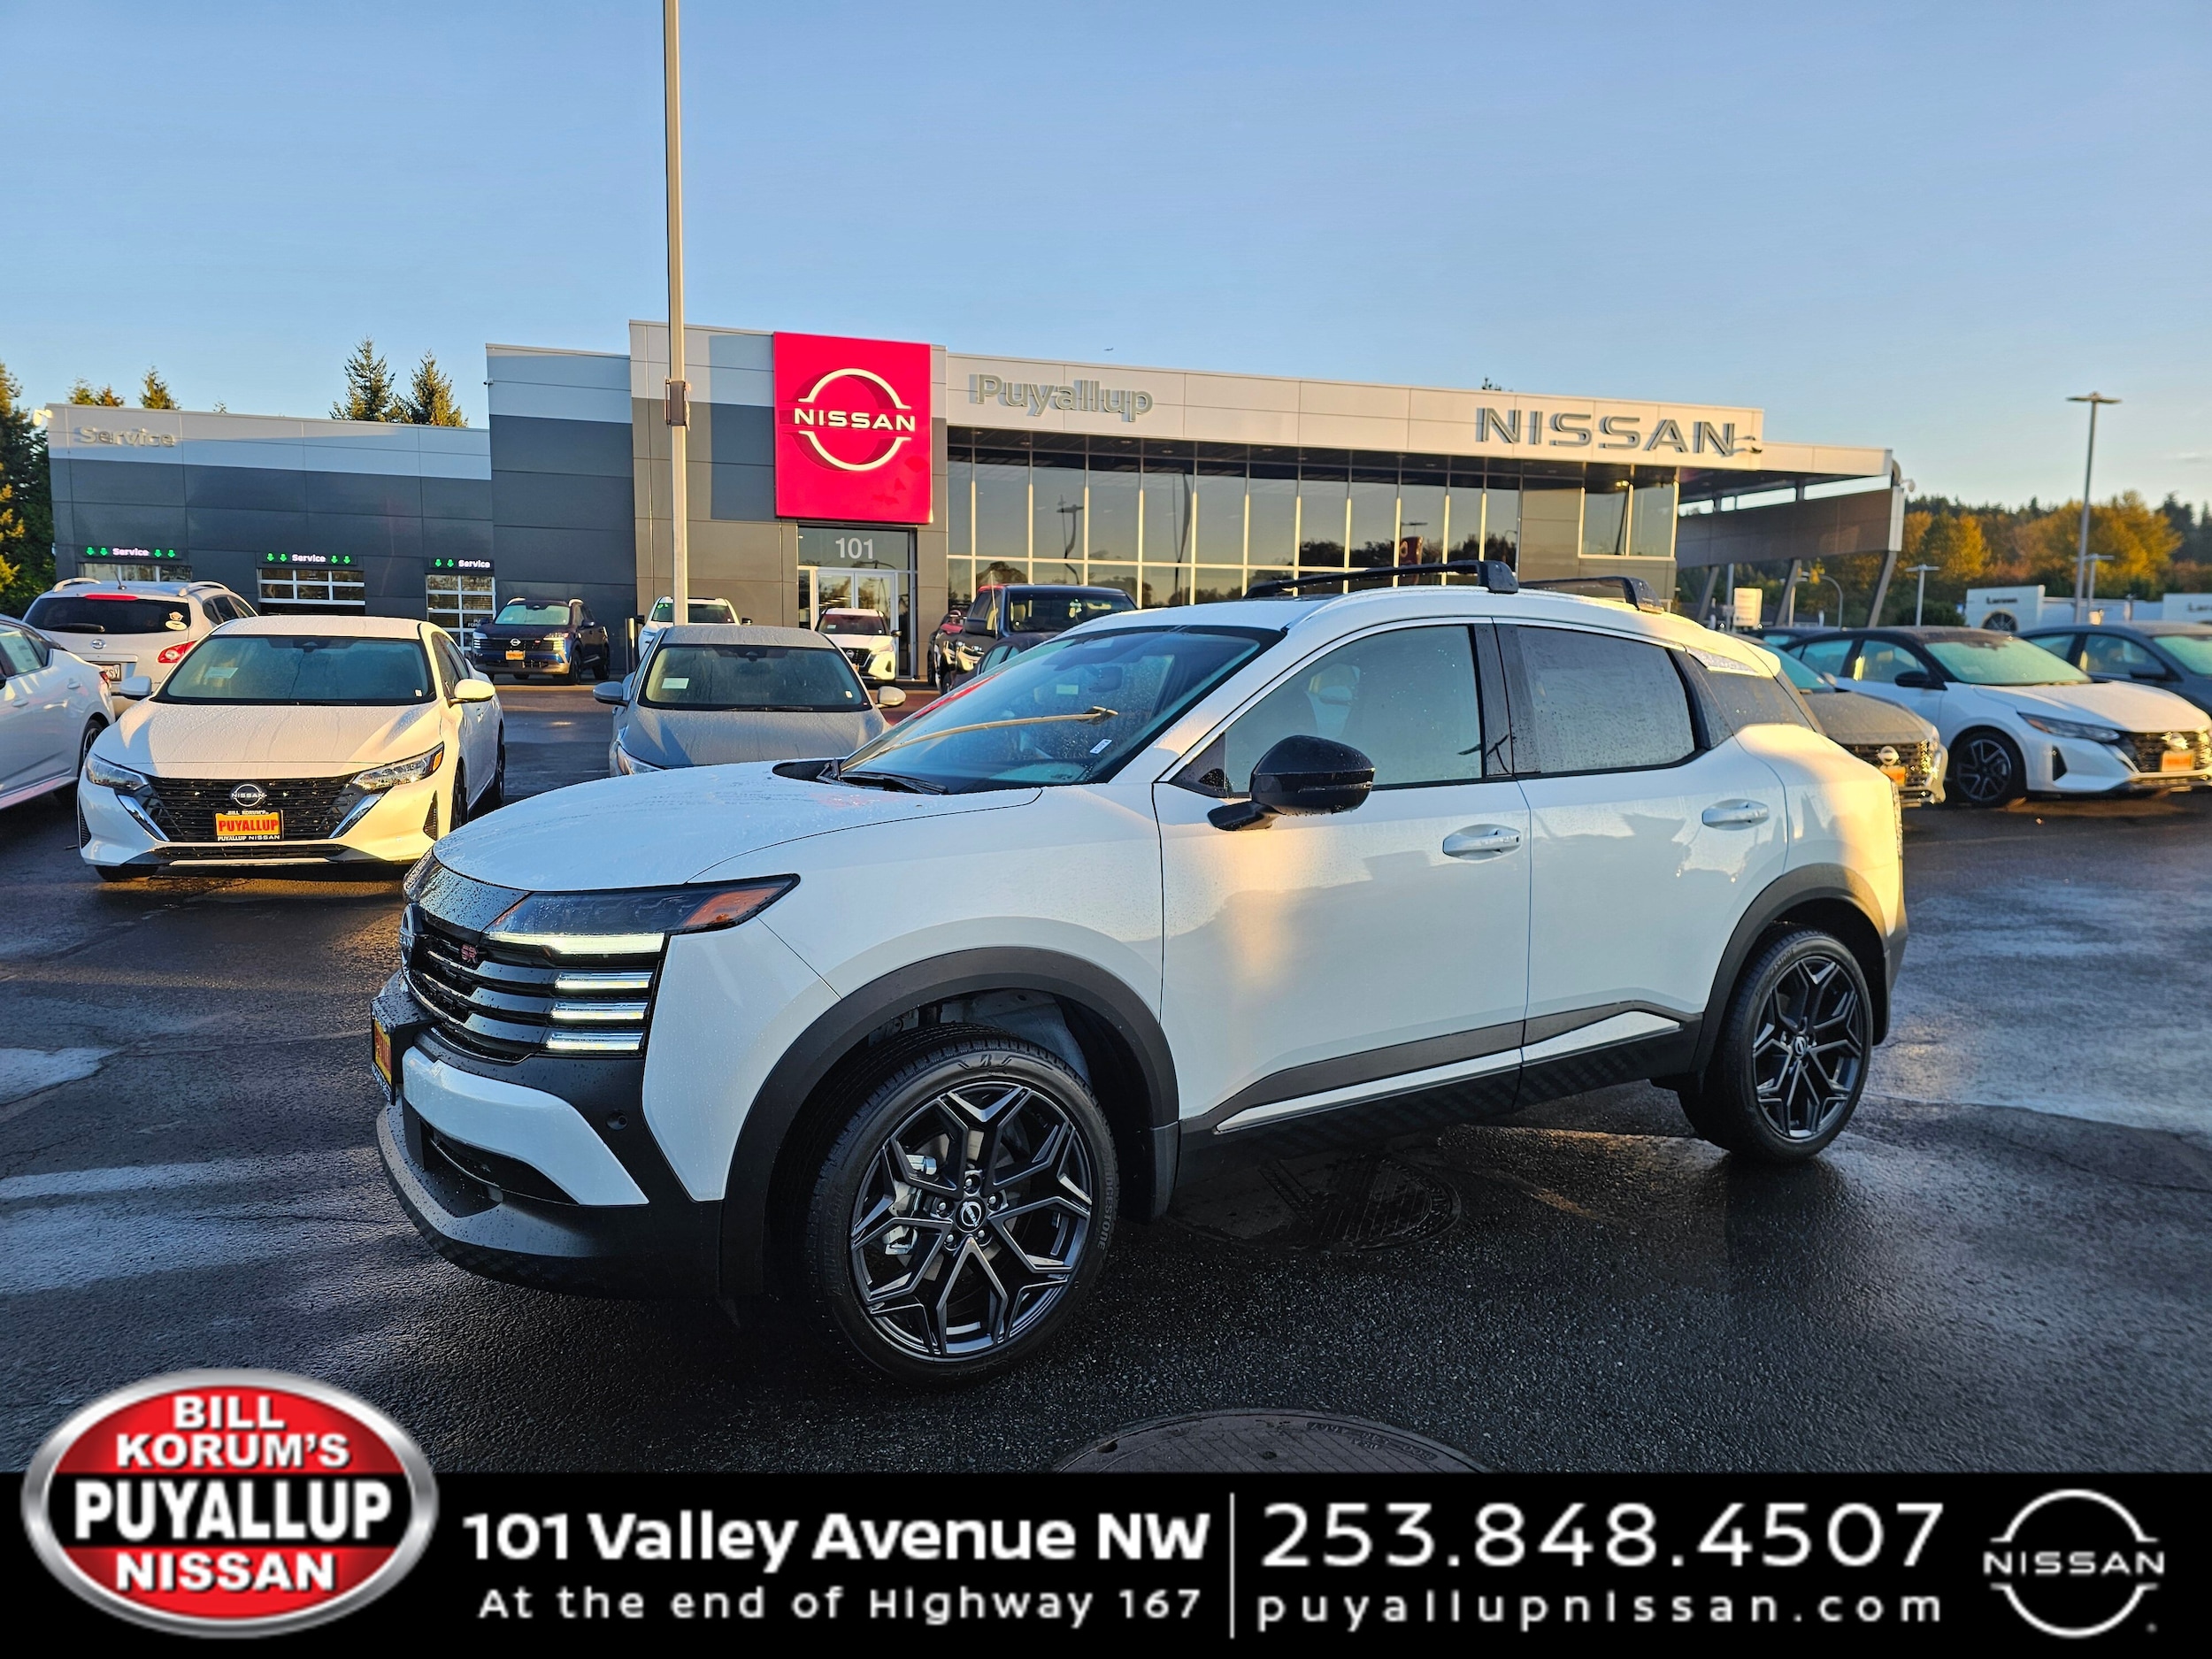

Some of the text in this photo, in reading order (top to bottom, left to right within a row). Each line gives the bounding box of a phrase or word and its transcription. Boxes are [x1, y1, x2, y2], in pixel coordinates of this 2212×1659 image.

[977, 374, 1153, 422] Puyallup
[794, 408, 916, 432] NISSAN
[80, 426, 175, 447] Service
[1479, 408, 1735, 457] NISSAN
[112, 548, 150, 557] Service
[291, 554, 326, 563] Service
[835, 537, 873, 559] 101
[458, 559, 491, 568] Service
[219, 819, 279, 832] PUYALLUP
